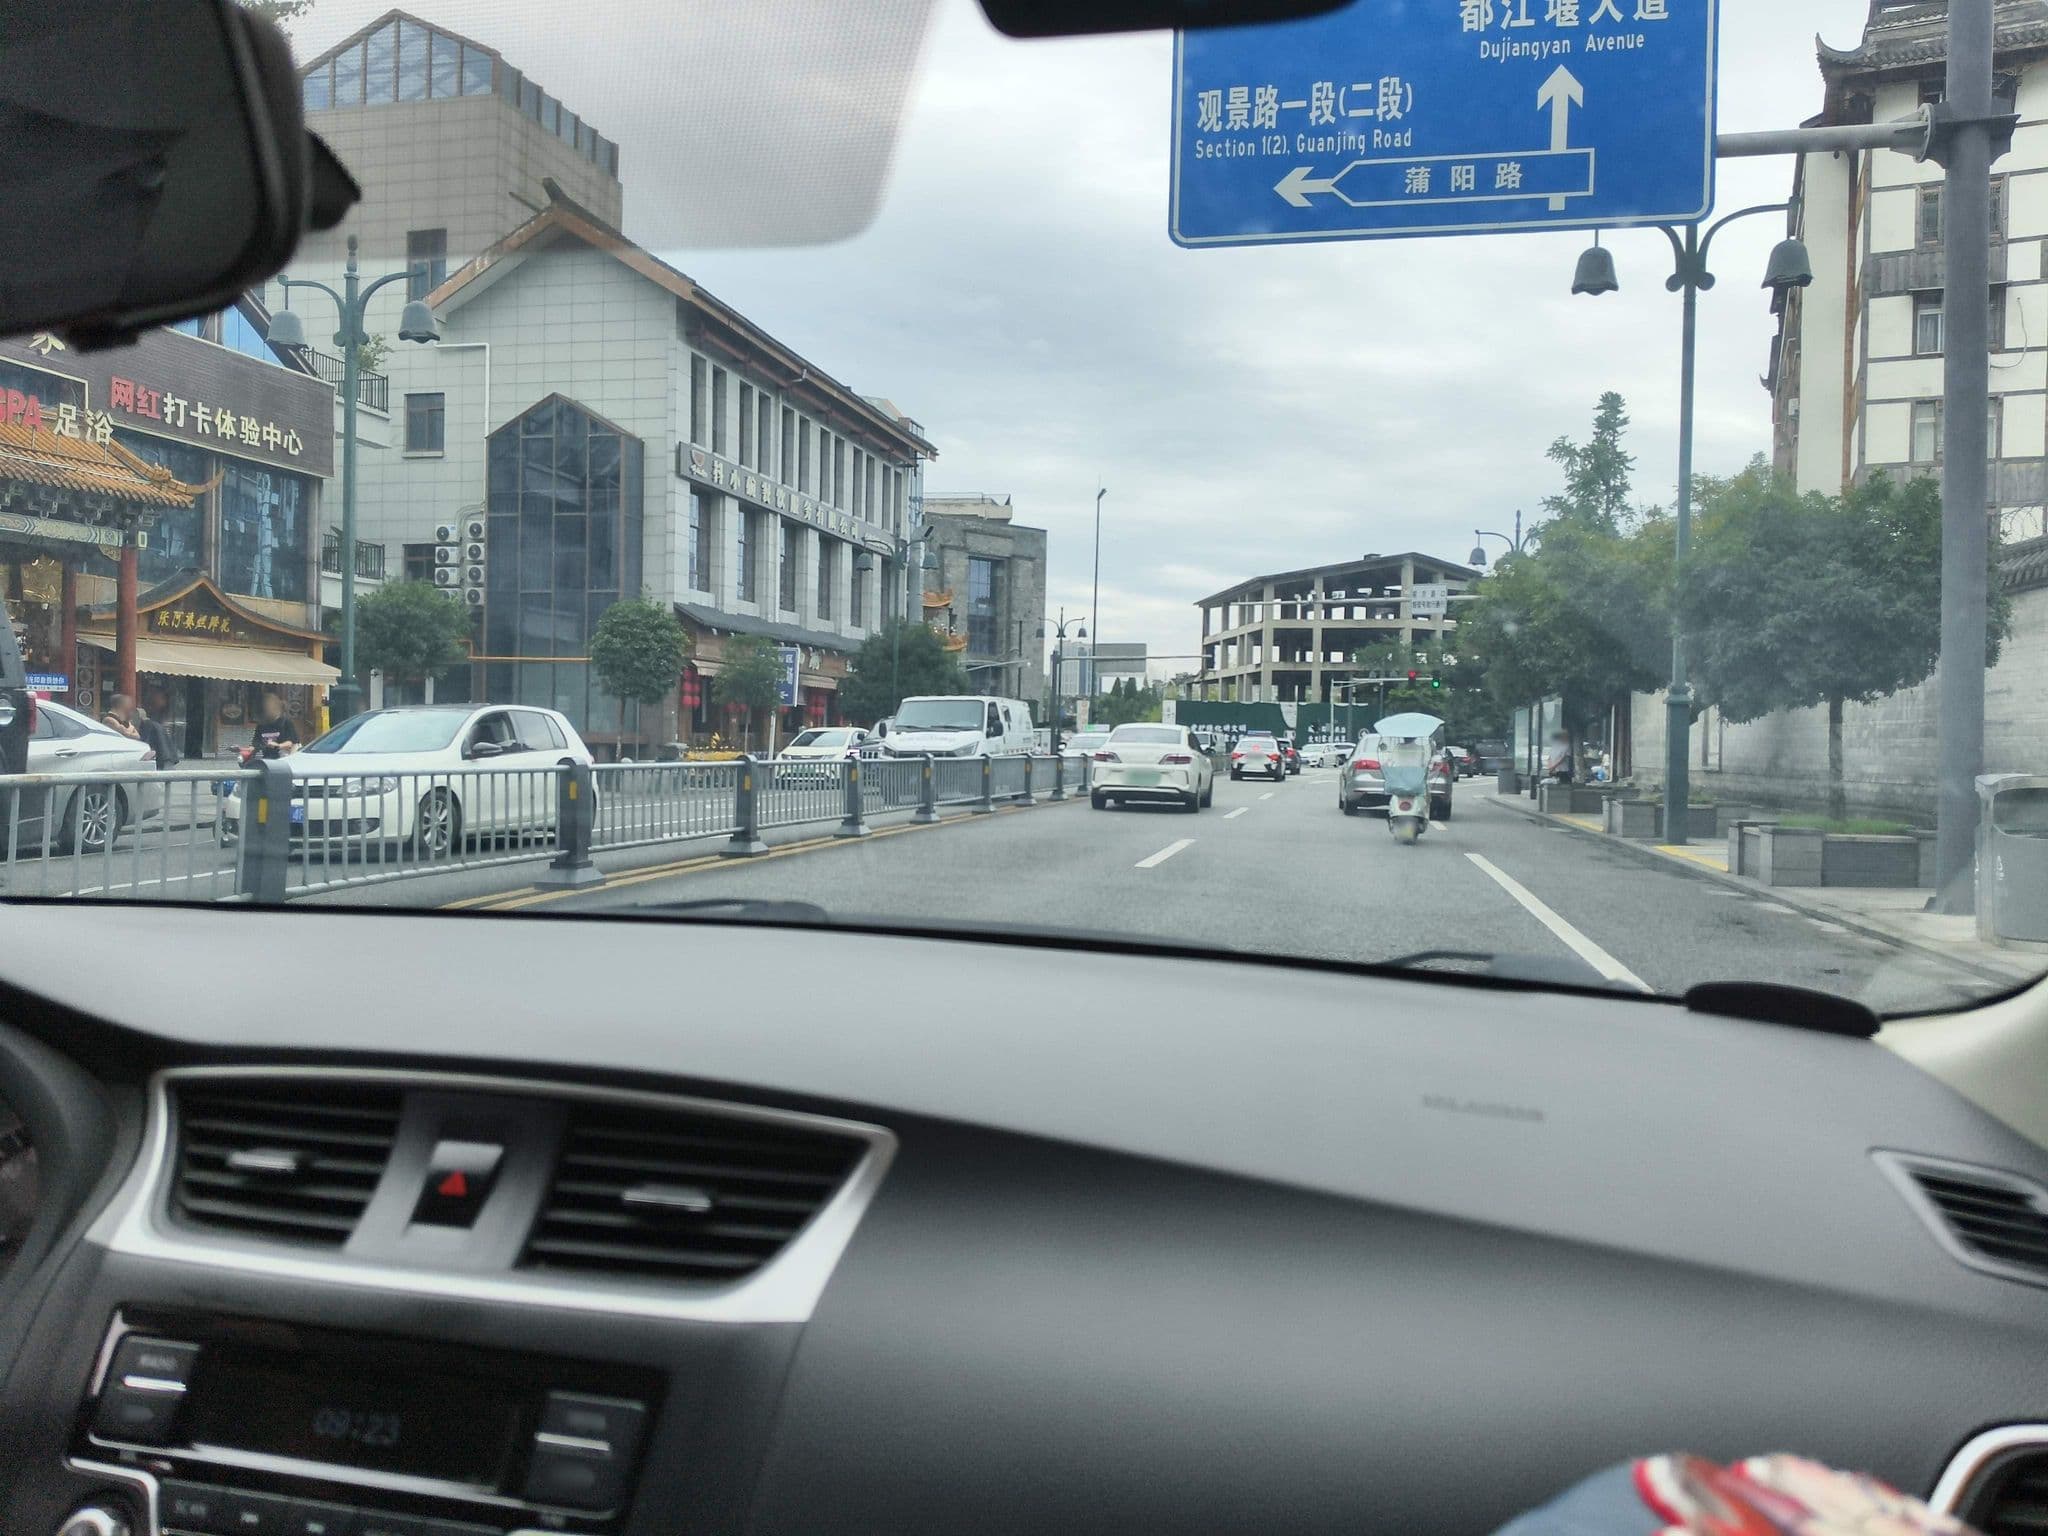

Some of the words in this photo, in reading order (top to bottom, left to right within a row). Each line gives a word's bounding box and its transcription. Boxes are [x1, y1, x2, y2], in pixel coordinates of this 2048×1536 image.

[1480, 37, 1570, 64] Dujiangyan
[1585, 33, 1645, 53] Avenue
[1197, 75, 1413, 133] 观景路一段(二段)
[1195, 139, 1255, 159] Section
[1297, 130, 1366, 156] Guanjing
[1373, 127, 1412, 150] Road
[1405, 161, 1523, 194] 蒲阳路
[53, 402, 114, 445] 足浴
[110, 375, 303, 456] 网红打卡体验中心
